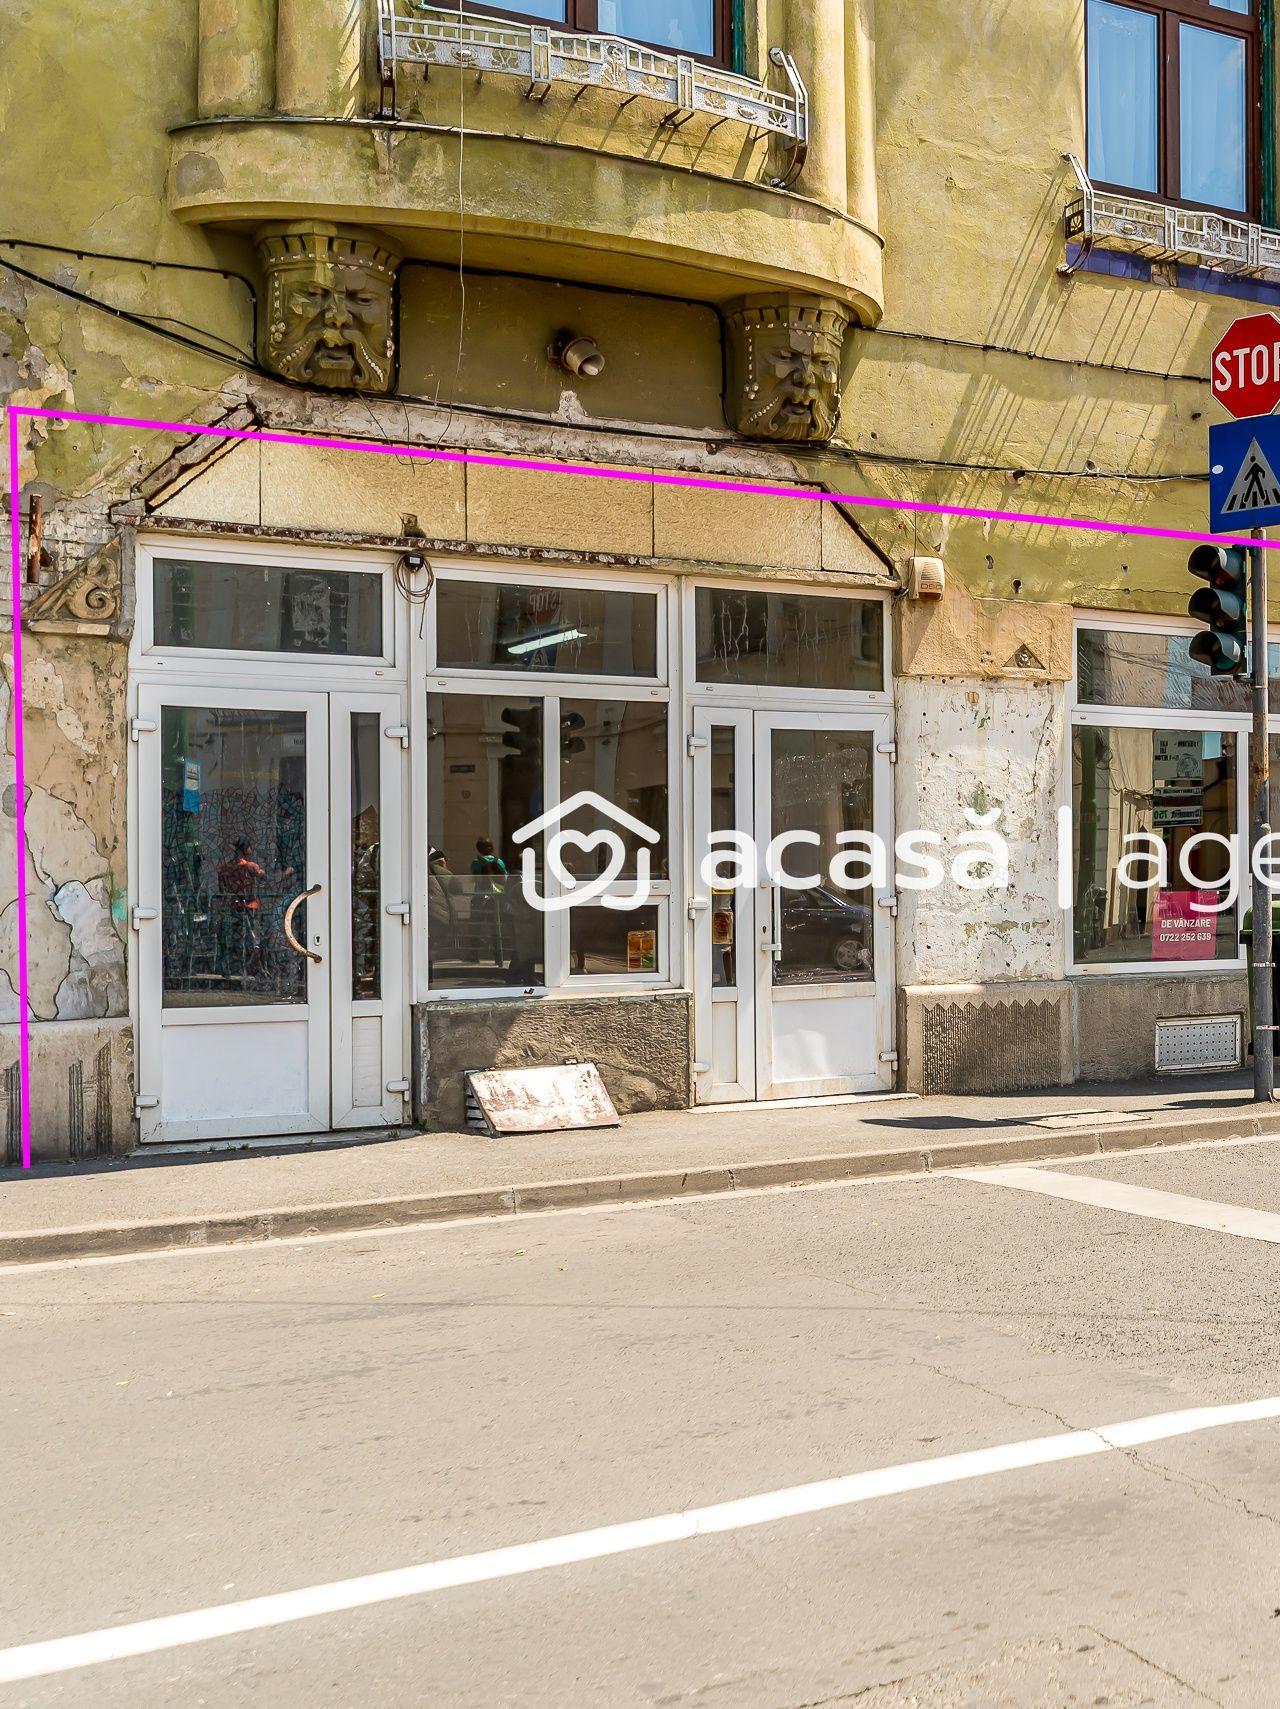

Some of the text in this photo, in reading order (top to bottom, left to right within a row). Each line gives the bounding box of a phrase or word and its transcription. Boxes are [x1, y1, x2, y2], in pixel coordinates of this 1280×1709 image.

[1161, 918, 1211, 928] DE VÂNZARE
[1160, 933, 1179, 942] 0722
